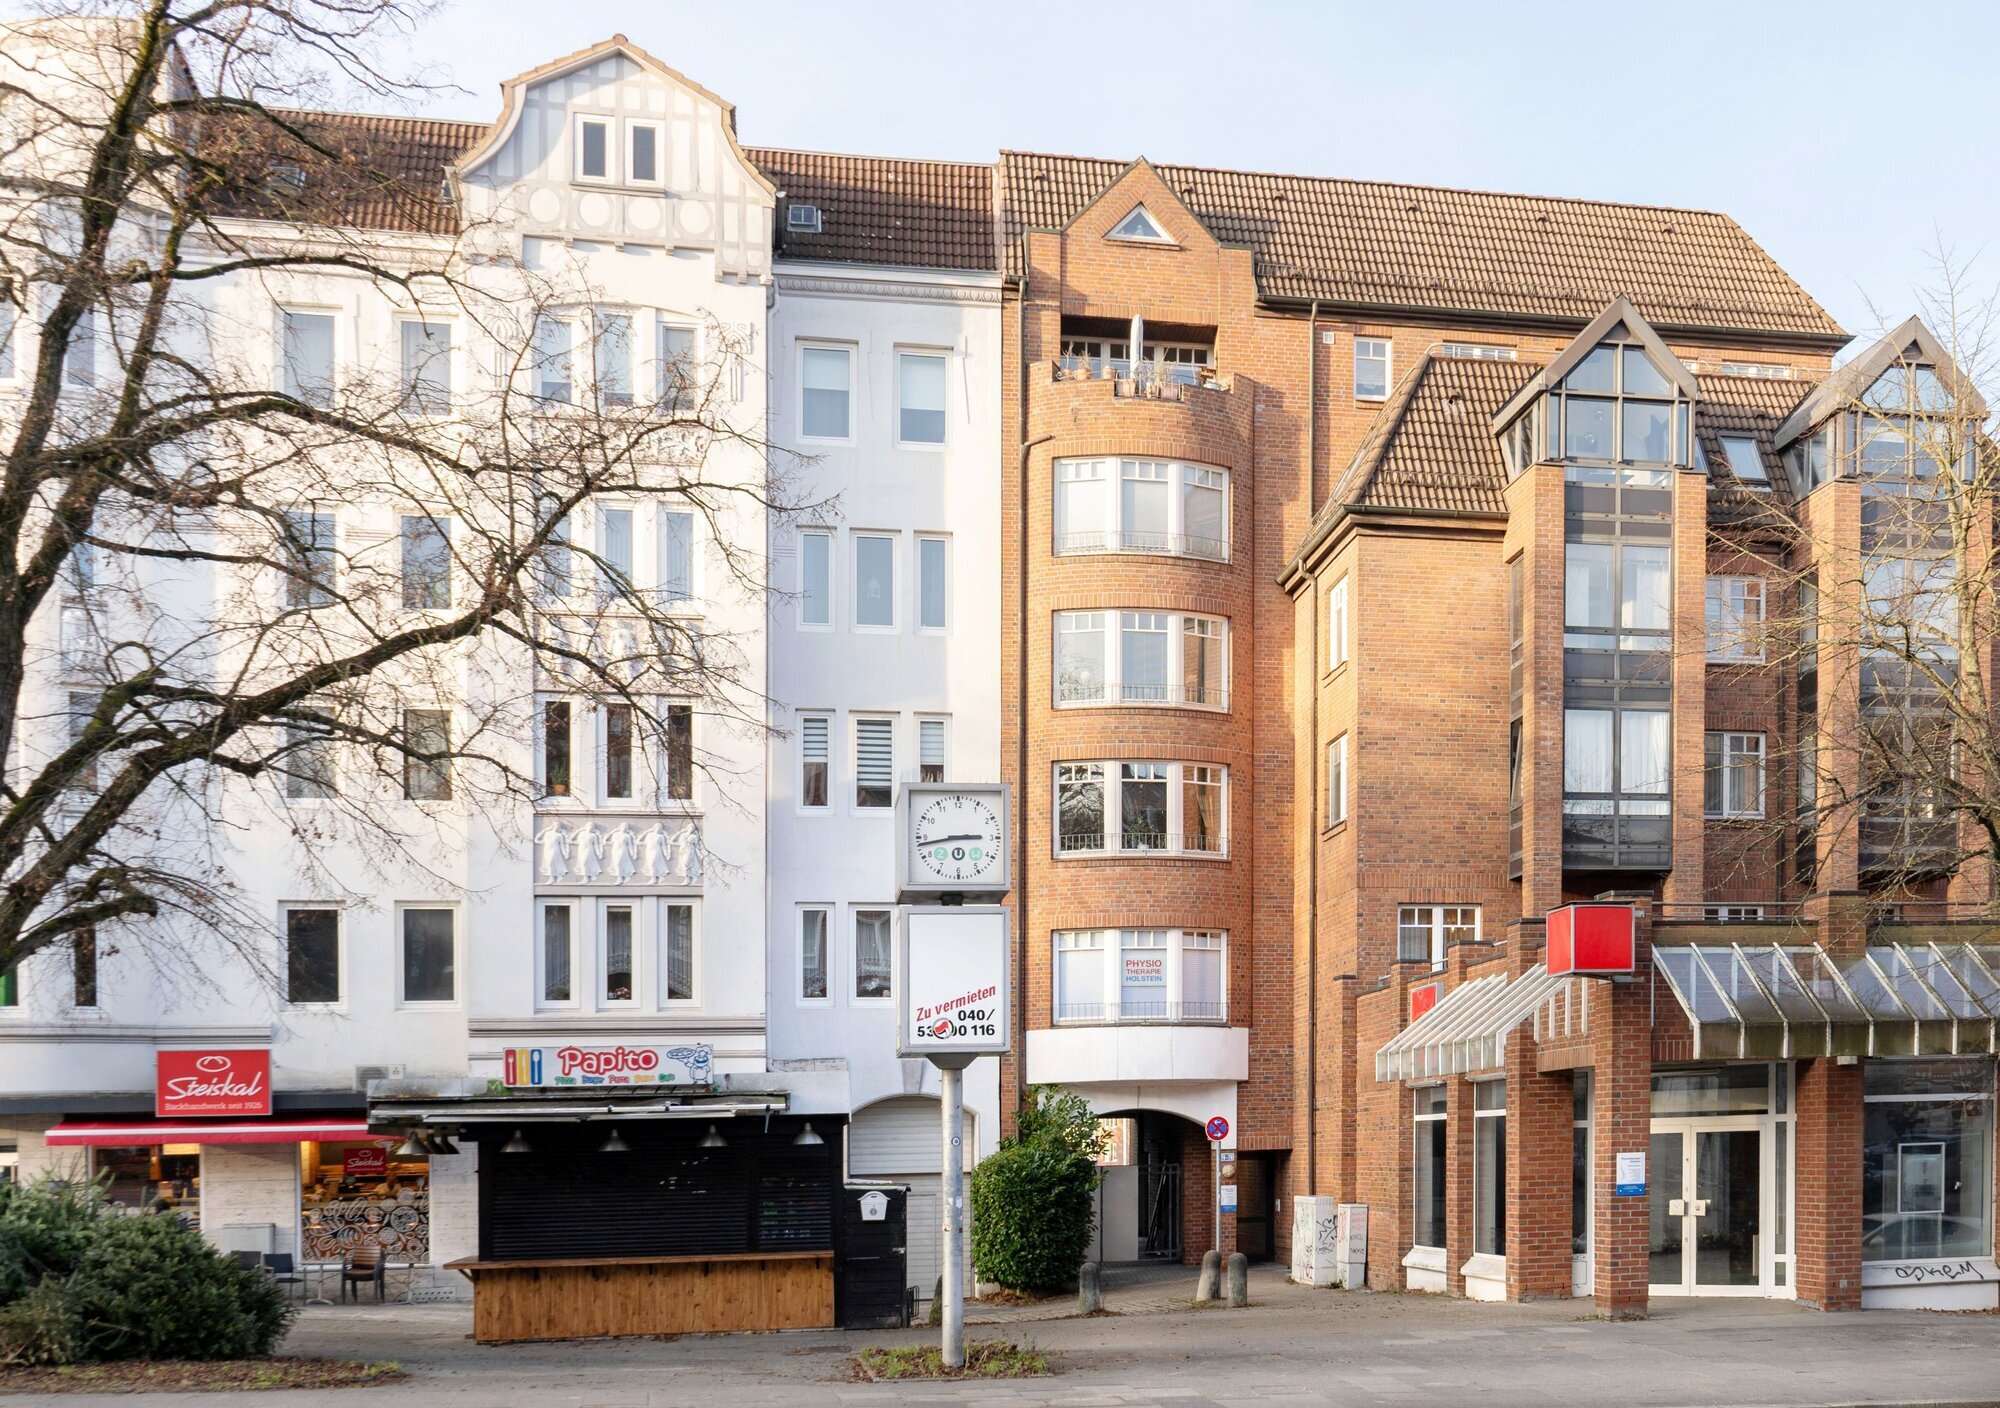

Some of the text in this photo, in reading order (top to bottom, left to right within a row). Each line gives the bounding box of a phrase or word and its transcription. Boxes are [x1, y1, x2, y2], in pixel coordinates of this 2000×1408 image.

[916, 986, 996, 1022] Zu vermieten
[958, 1009, 995, 1021] 040/
[971, 1024, 995, 1036] 116
[557, 1046, 659, 1076] Papito
[608, 1074, 630, 1083] Pasta
[165, 1072, 262, 1100] Steiskal
[165, 1103, 226, 1111] Backhandwerk
